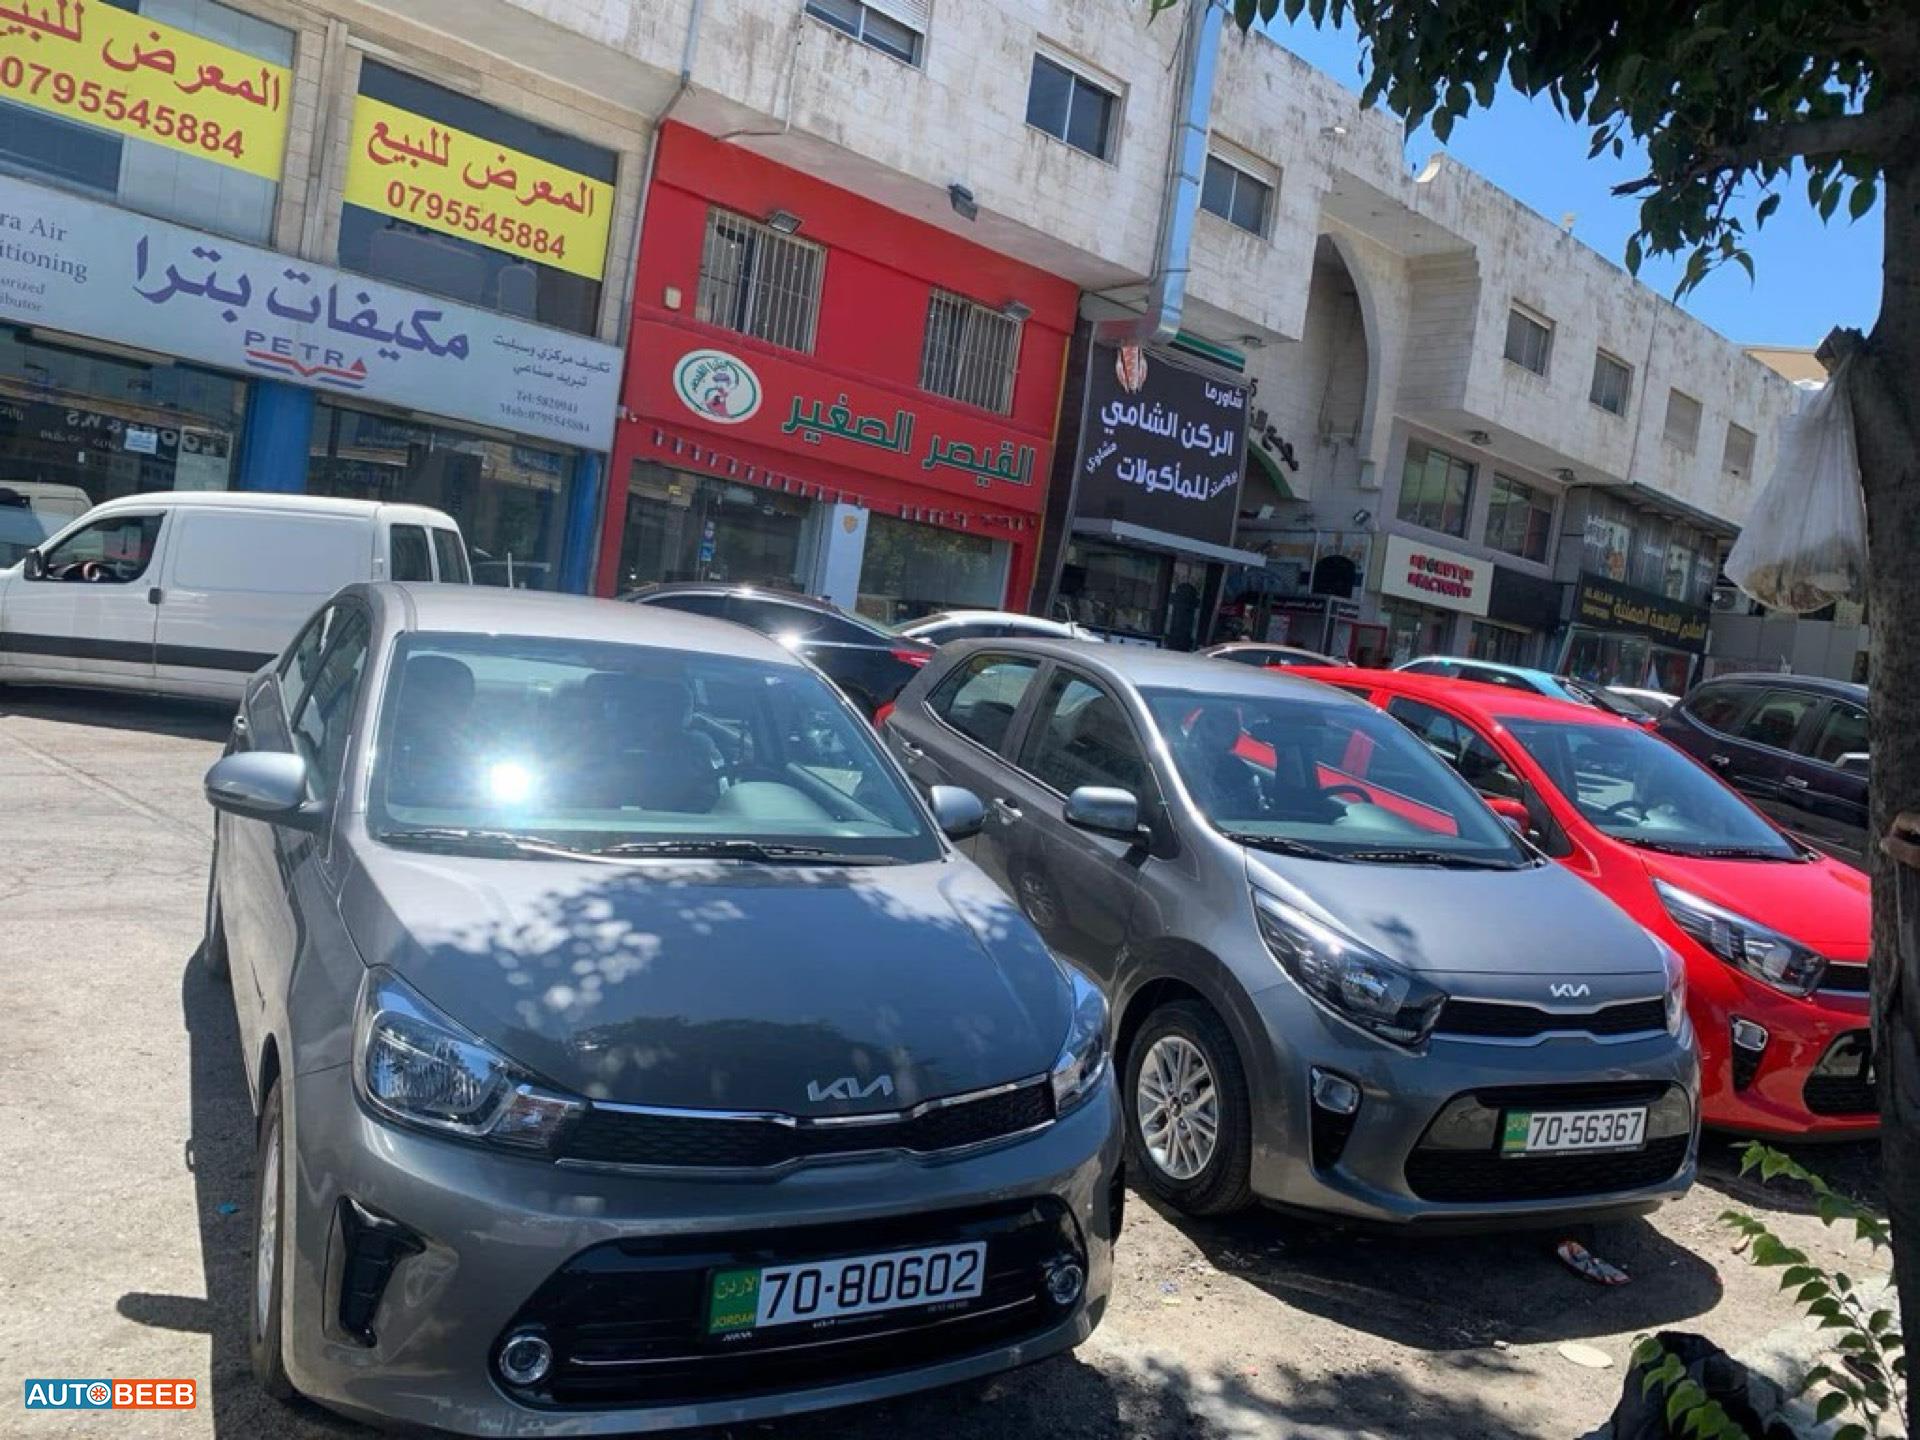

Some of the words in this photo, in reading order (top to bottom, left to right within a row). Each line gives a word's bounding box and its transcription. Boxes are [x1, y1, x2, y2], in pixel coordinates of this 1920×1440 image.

[101, 30, 280, 111] المعرض
[1, 56, 244, 159] 0795545884
[367, 121, 451, 167] للبيع
[462, 153, 594, 217] المعرض
[29, 217, 68, 241] Air
[387, 180, 566, 259] 0795545884
[132, 234, 252, 323] بترا
[267, 268, 470, 361] مكيفات
[782, 392, 915, 455] الصغير
[1101, 399, 1179, 438] الشامي
[1204, 381, 1245, 409] شاورما
[922, 434, 1035, 488] القيصر
[1180, 421, 1235, 457] الركن
[1116, 455, 1211, 501] للمأكولات
[1532, 1111, 1642, 1147] 70-56367
[765, 1249, 979, 1320] 70-80602
